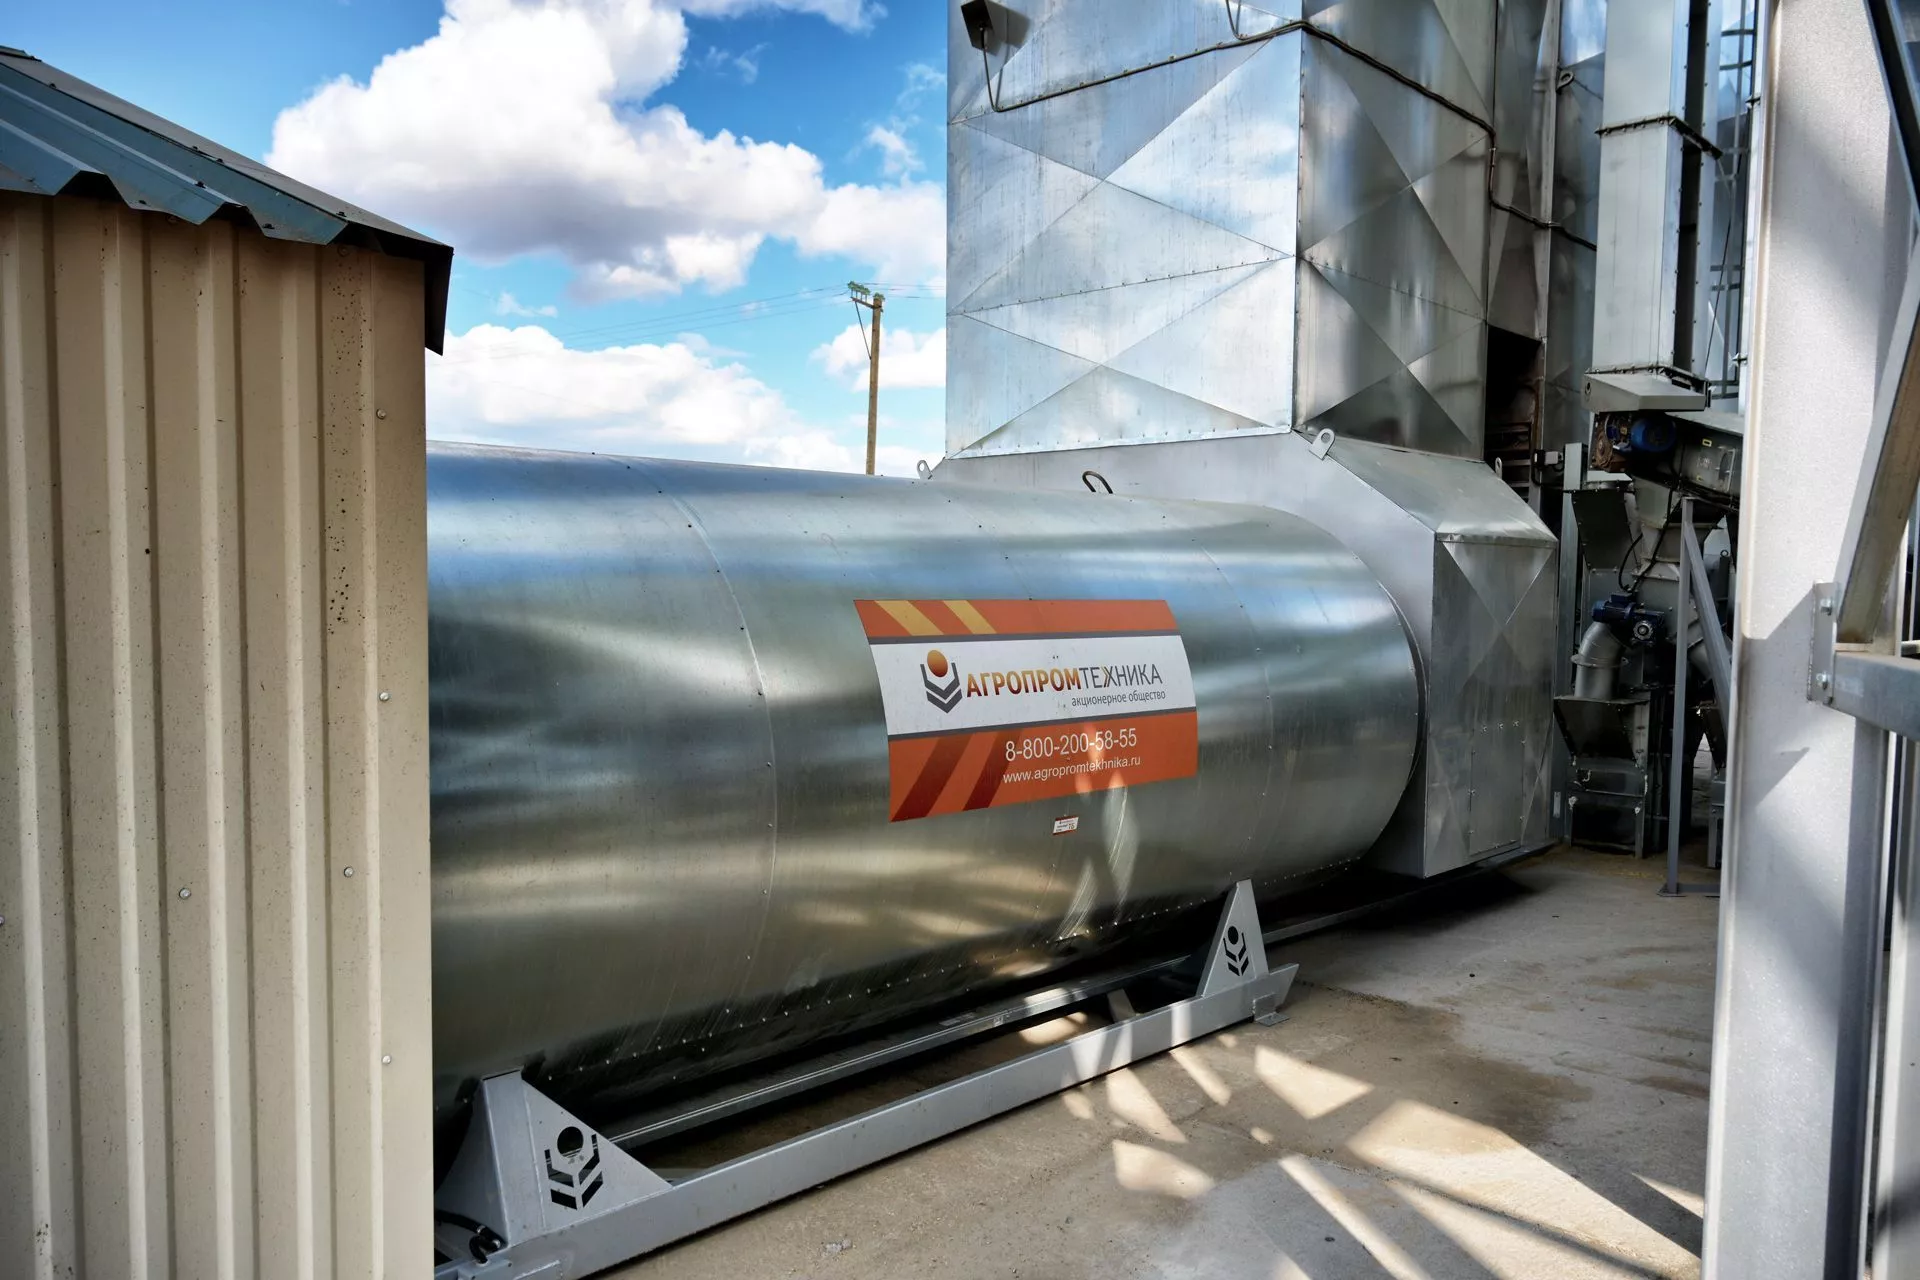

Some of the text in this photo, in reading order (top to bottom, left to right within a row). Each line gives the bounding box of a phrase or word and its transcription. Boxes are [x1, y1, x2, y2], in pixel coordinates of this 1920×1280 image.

[967, 664, 1162, 698] АГРОПРОМТЕХНИКА
[1071, 690, 1166, 707] акционерное общество
[1005, 728, 1138, 761] 8-800-200-58-55
[1003, 756, 1141, 783] www.agropromtekhnika.ru
